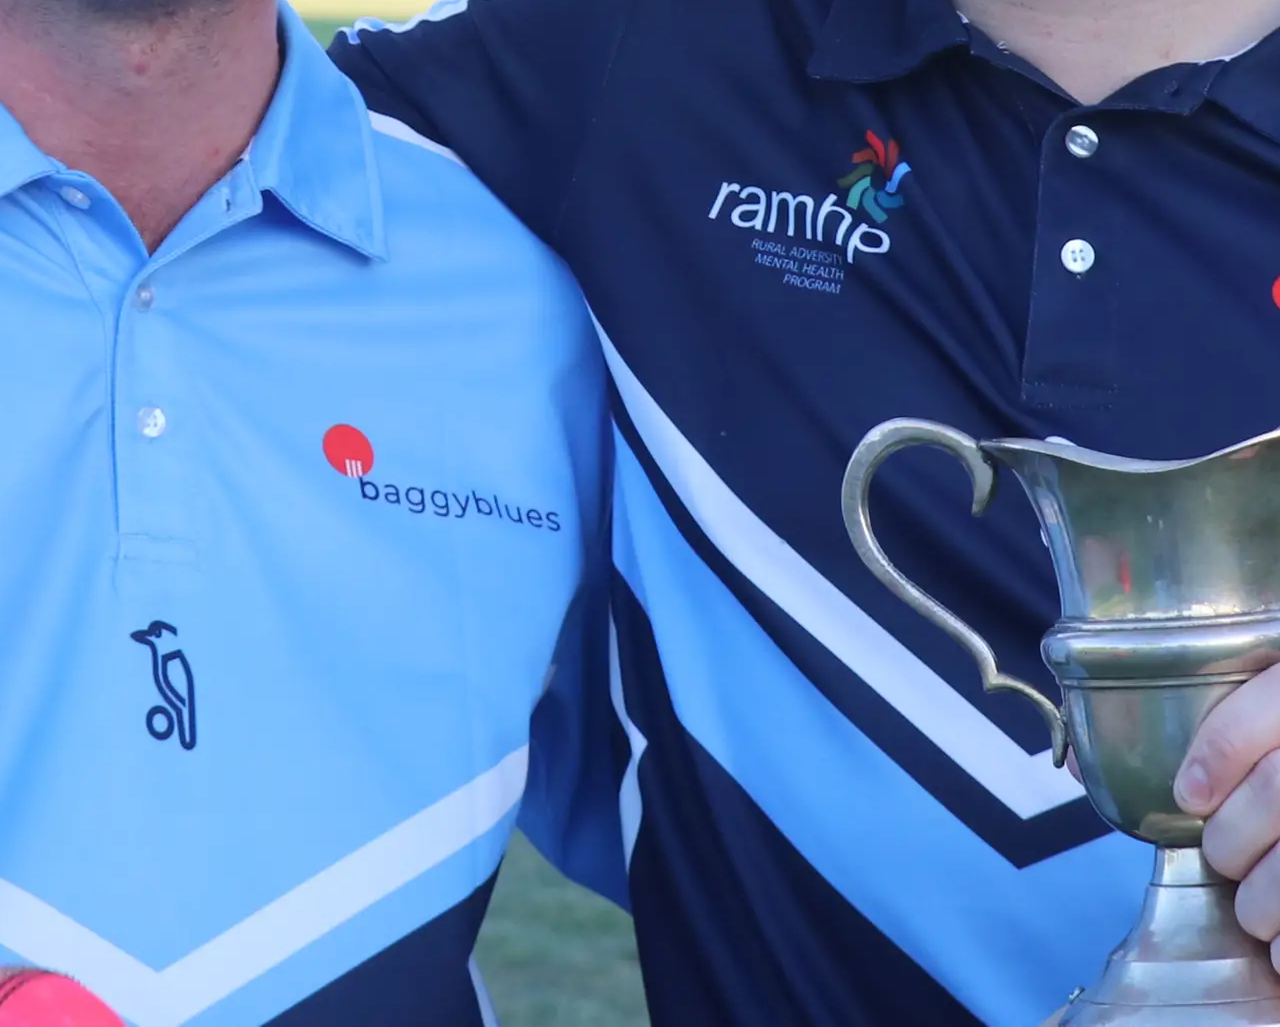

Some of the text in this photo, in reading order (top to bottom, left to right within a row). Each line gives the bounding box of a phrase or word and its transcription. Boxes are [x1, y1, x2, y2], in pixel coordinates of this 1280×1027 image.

[707, 181, 891, 264] ramhp
[751, 237, 844, 266] RURAL ADVERSITY
[754, 253, 845, 281] MENTAL HEALTH
[782, 273, 841, 294] PROGRAM
[358, 470, 562, 532] baggyblues
